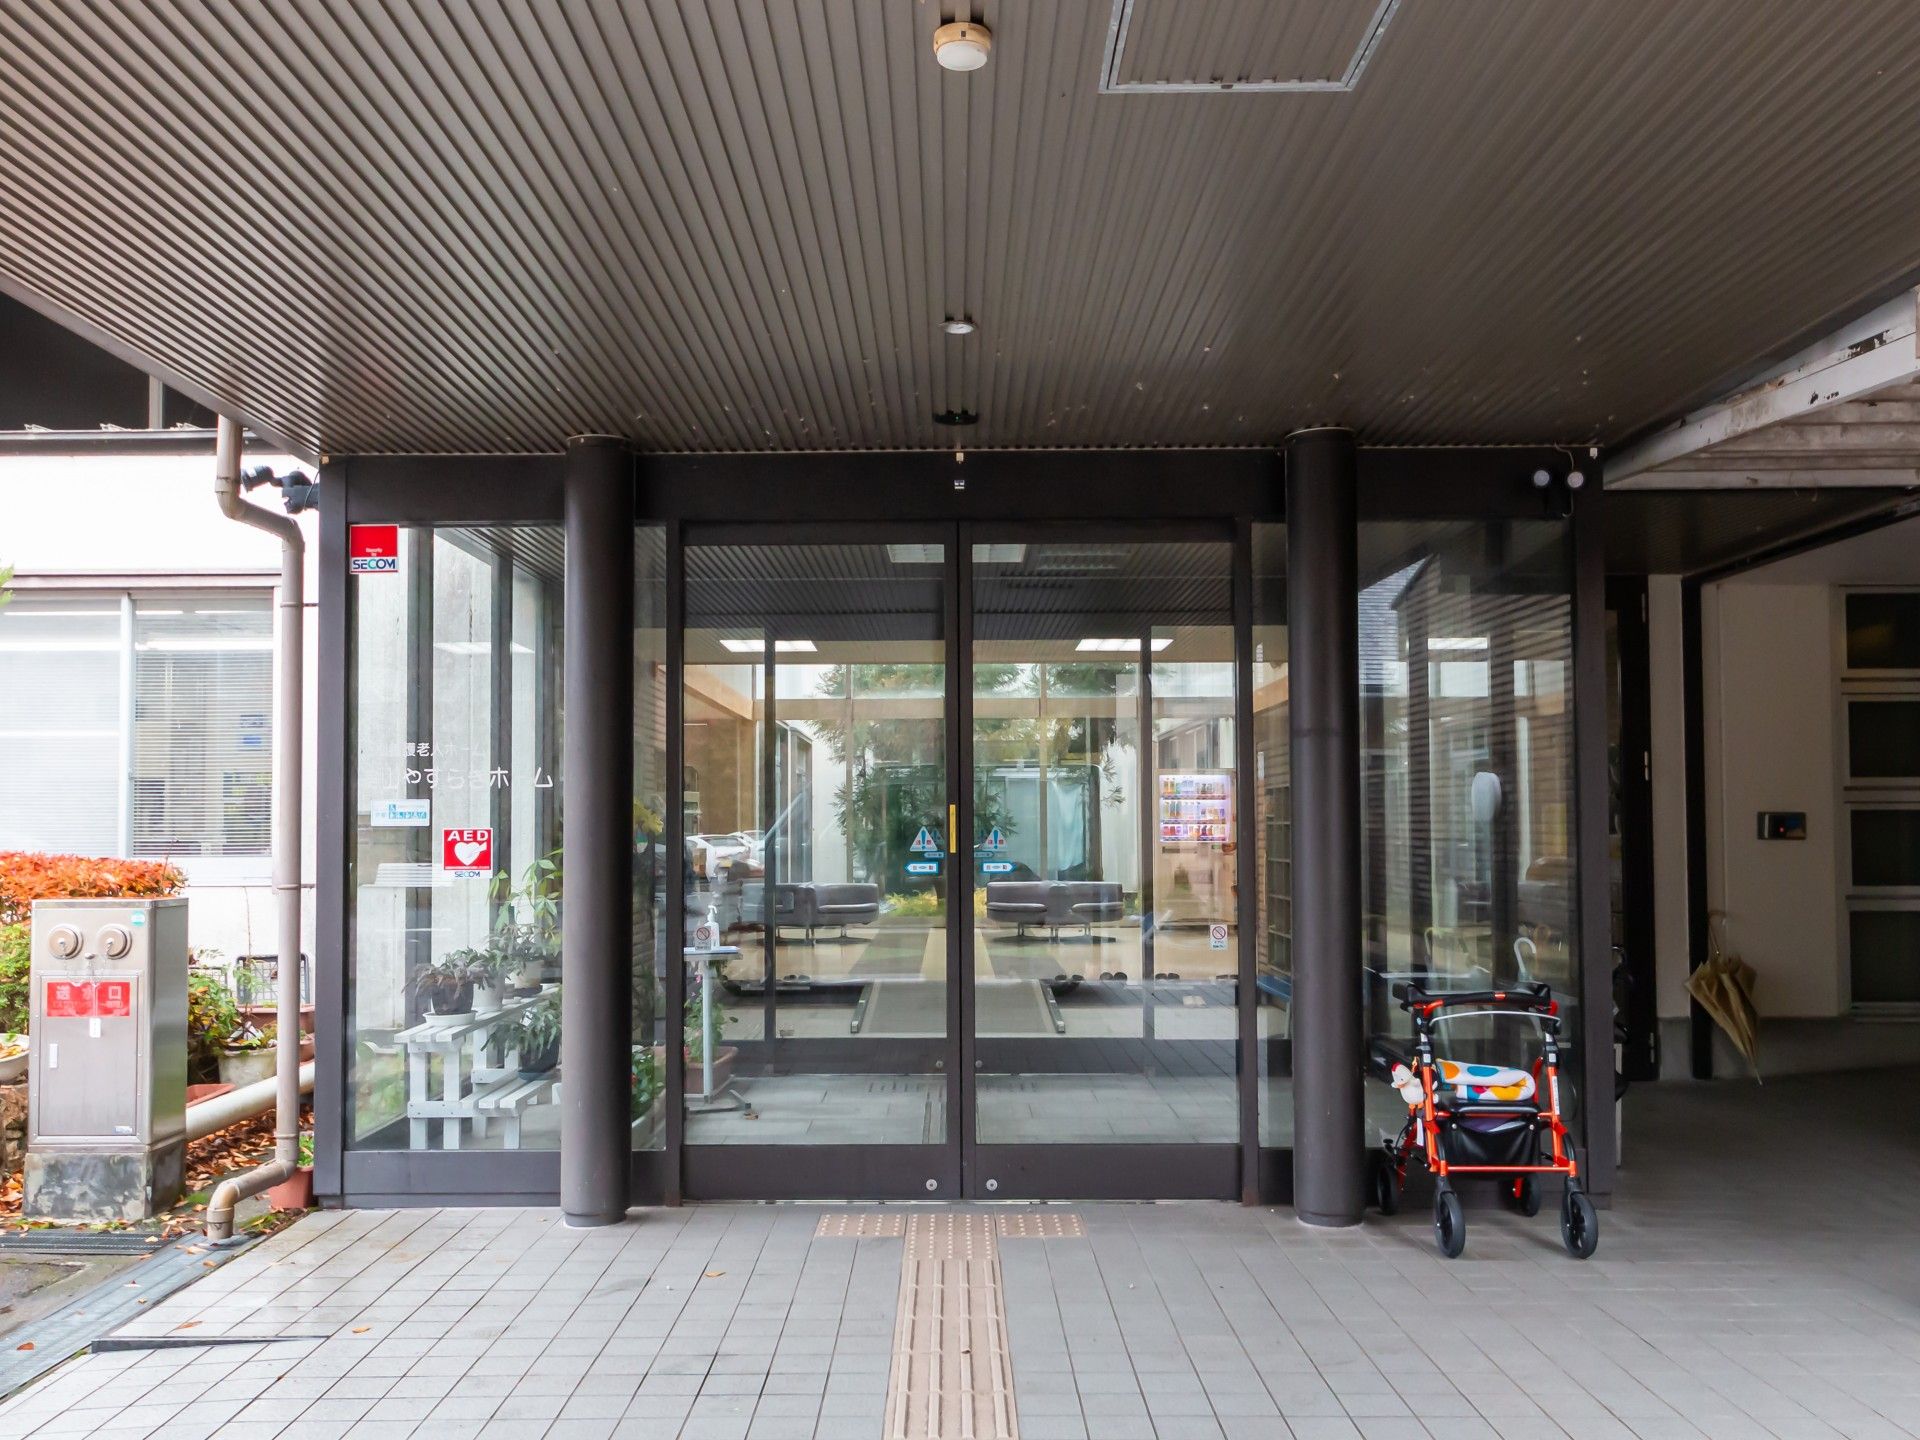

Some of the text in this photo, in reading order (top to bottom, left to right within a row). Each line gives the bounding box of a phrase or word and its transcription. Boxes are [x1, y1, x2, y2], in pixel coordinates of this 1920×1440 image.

[352, 558, 396, 570] SECOM
[447, 830, 489, 842] AED
[454, 870, 481, 878] SECOM
